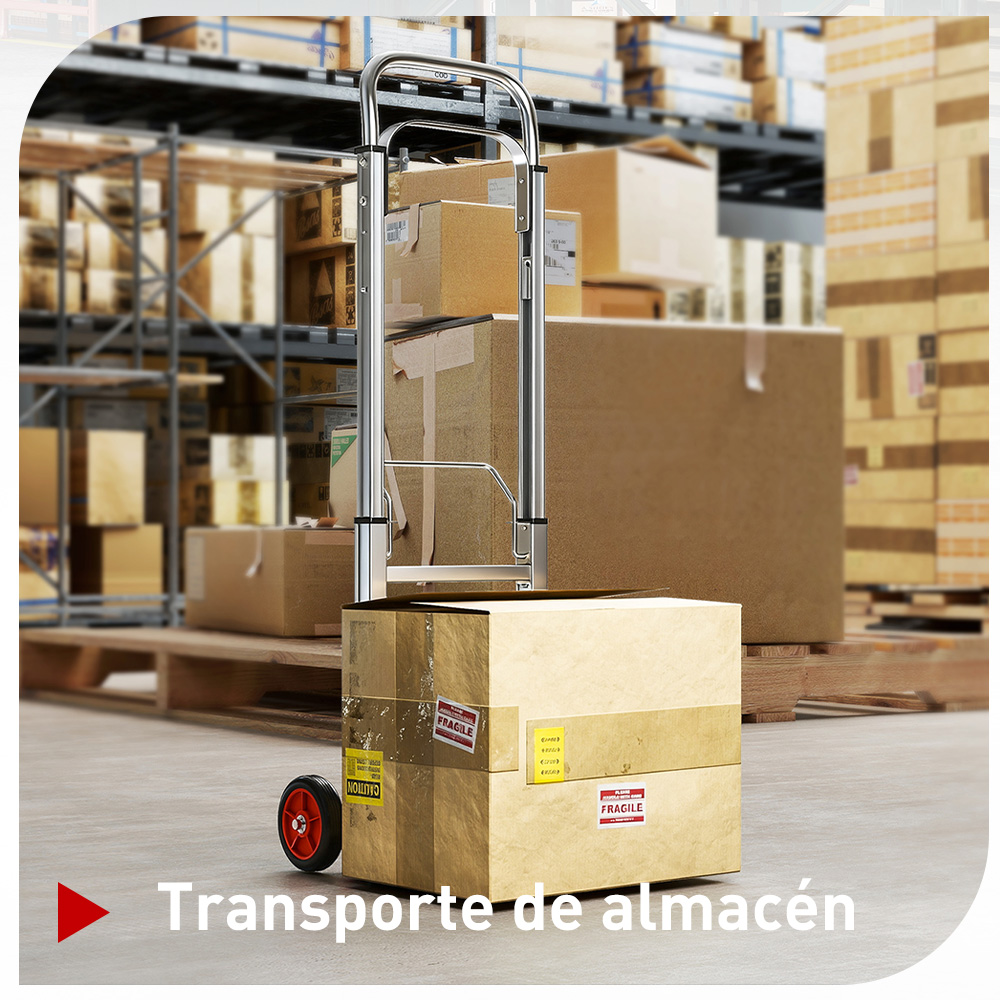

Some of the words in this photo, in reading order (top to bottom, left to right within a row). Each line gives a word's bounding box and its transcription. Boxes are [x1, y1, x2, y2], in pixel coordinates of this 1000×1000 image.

[437, 715, 473, 737] FRAGILE
[347, 781, 380, 797] CAUTION
[601, 802, 643, 814] FRAGILE
